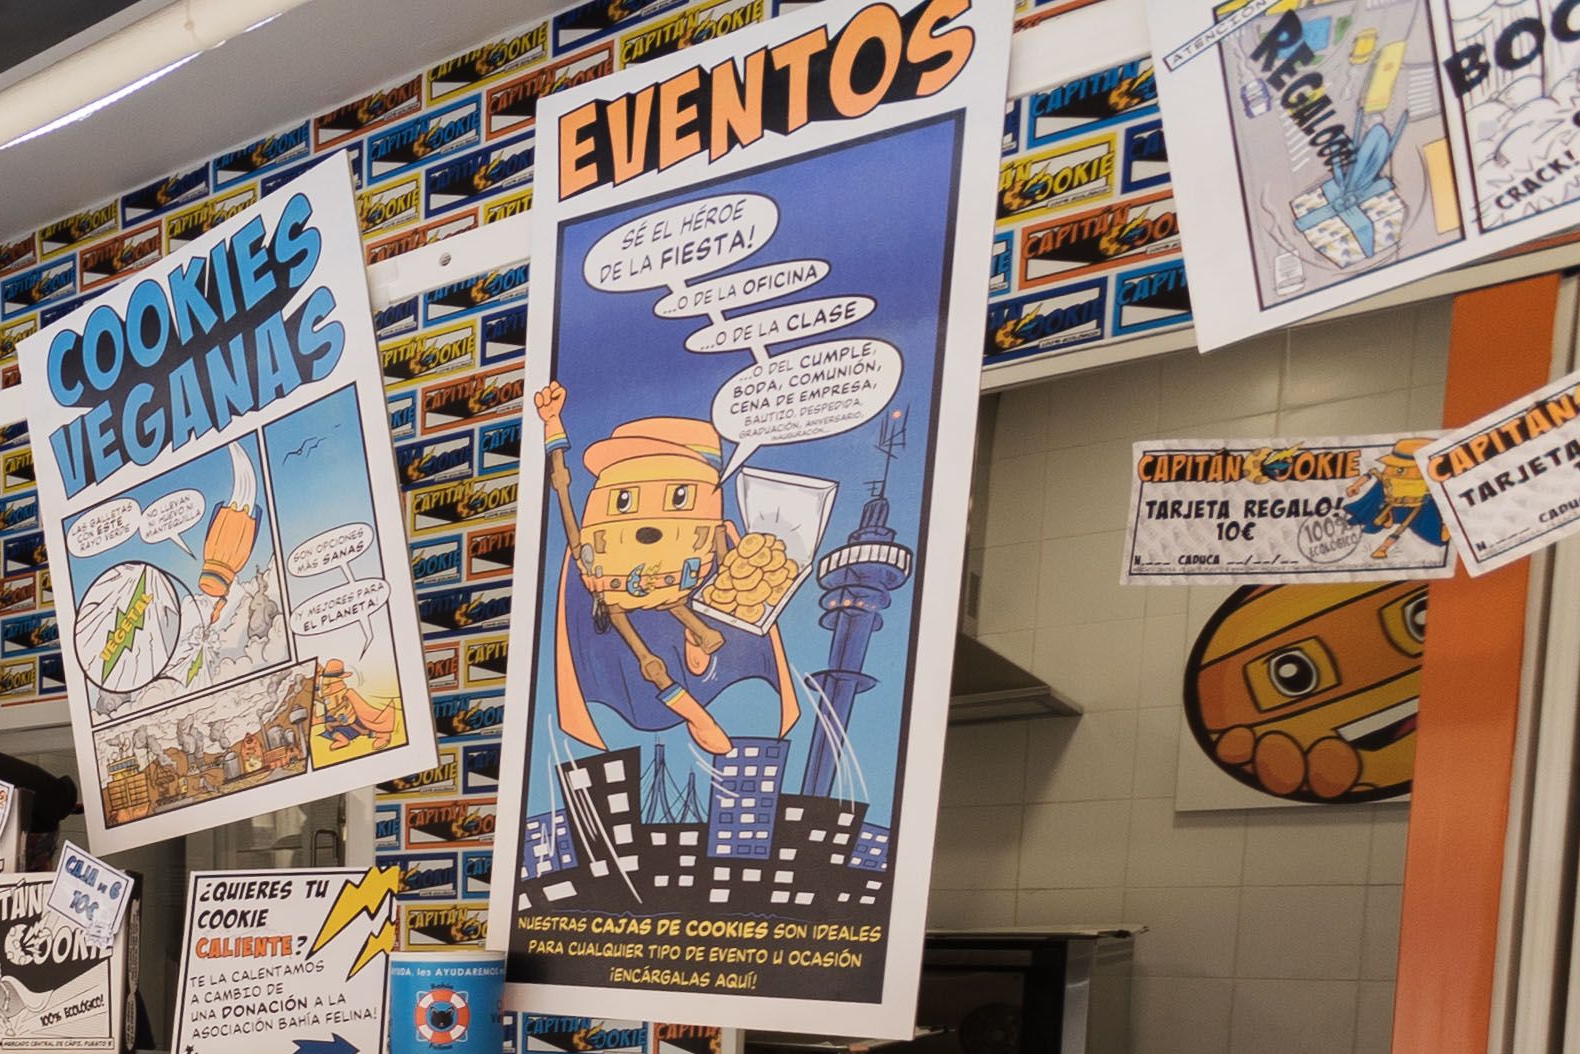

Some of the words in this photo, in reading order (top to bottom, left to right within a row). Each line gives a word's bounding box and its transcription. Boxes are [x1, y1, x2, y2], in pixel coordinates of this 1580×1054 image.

[558, 0, 976, 201] EVENTOS
[1495, 150, 1580, 209] CRACK!
[621, 222, 647, 251] SÉ
[652, 221, 672, 242] EL
[680, 199, 747, 236] HÉROE
[600, 261, 622, 283] DE
[630, 255, 652, 277] LA
[660, 225, 755, 270] FIESTA!
[47, 193, 321, 407] COOKIES
[693, 289, 714, 307] DE
[718, 284, 737, 301] LA
[742, 264, 818, 296] OFICINA
[733, 324, 753, 343] DE
[758, 319, 780, 337] LA
[787, 299, 858, 338] CLASE
[733, 380, 783, 399] BODA,
[788, 359, 882, 388] COMUNIÓN,
[768, 360, 793, 375] DEL
[49, 286, 346, 499] VEGANAS
[730, 399, 770, 415] CENA
[776, 393, 794, 407] DE
[799, 379, 877, 403] EMPRESA,
[1138, 448, 1244, 484] CAPITÁN
[1145, 500, 1230, 520] TARJETA
[1244, 496, 1343, 519] REGALO!
[1217, 521, 1257, 542] 10€
[323, 541, 364, 565] SANAS
[99, 593, 154, 661] VEGETAL
[65, 855, 99, 887] CAJA
[199, 880, 293, 902] ¿QUIERES
[305, 879, 330, 899] TU
[197, 909, 269, 929] COOKIE
[518, 916, 587, 932] NUESTRAS
[591, 918, 652, 935] CAJAS
[656, 919, 681, 936] DE
[685, 920, 769, 939] COOKIES
[773, 924, 808, 939] SON
[812, 924, 882, 942] IDEALES
[528, 940, 564, 955] PARA
[568, 942, 643, 958] CUALQUIER
[648, 944, 681, 961] TIPO
[685, 946, 705, 961] DE
[708, 947, 768, 964] EVENTO
[788, 949, 862, 968] OCASIÓN
[189, 976, 205, 988] TE
[210, 973, 227, 986] LA
[231, 959, 325, 983] CALENTAMOS
[609, 966, 711, 988] ¡ENCÁRGALAS
[715, 971, 758, 990] AQUÍ!
[189, 994, 199, 1005] A
[204, 985, 261, 1004] CAMBIO
[267, 983, 284, 995] DE
[191, 1009, 217, 1022] UNA
[222, 995, 308, 1019] DONACIÓN
[314, 995, 323, 1006] A
[328, 993, 347, 1006] LA
[192, 1017, 273, 1039] ASOCIACIÓN
[278, 1013, 321, 1030] BAHÍA
[325, 1007, 378, 1024] FELINA!
